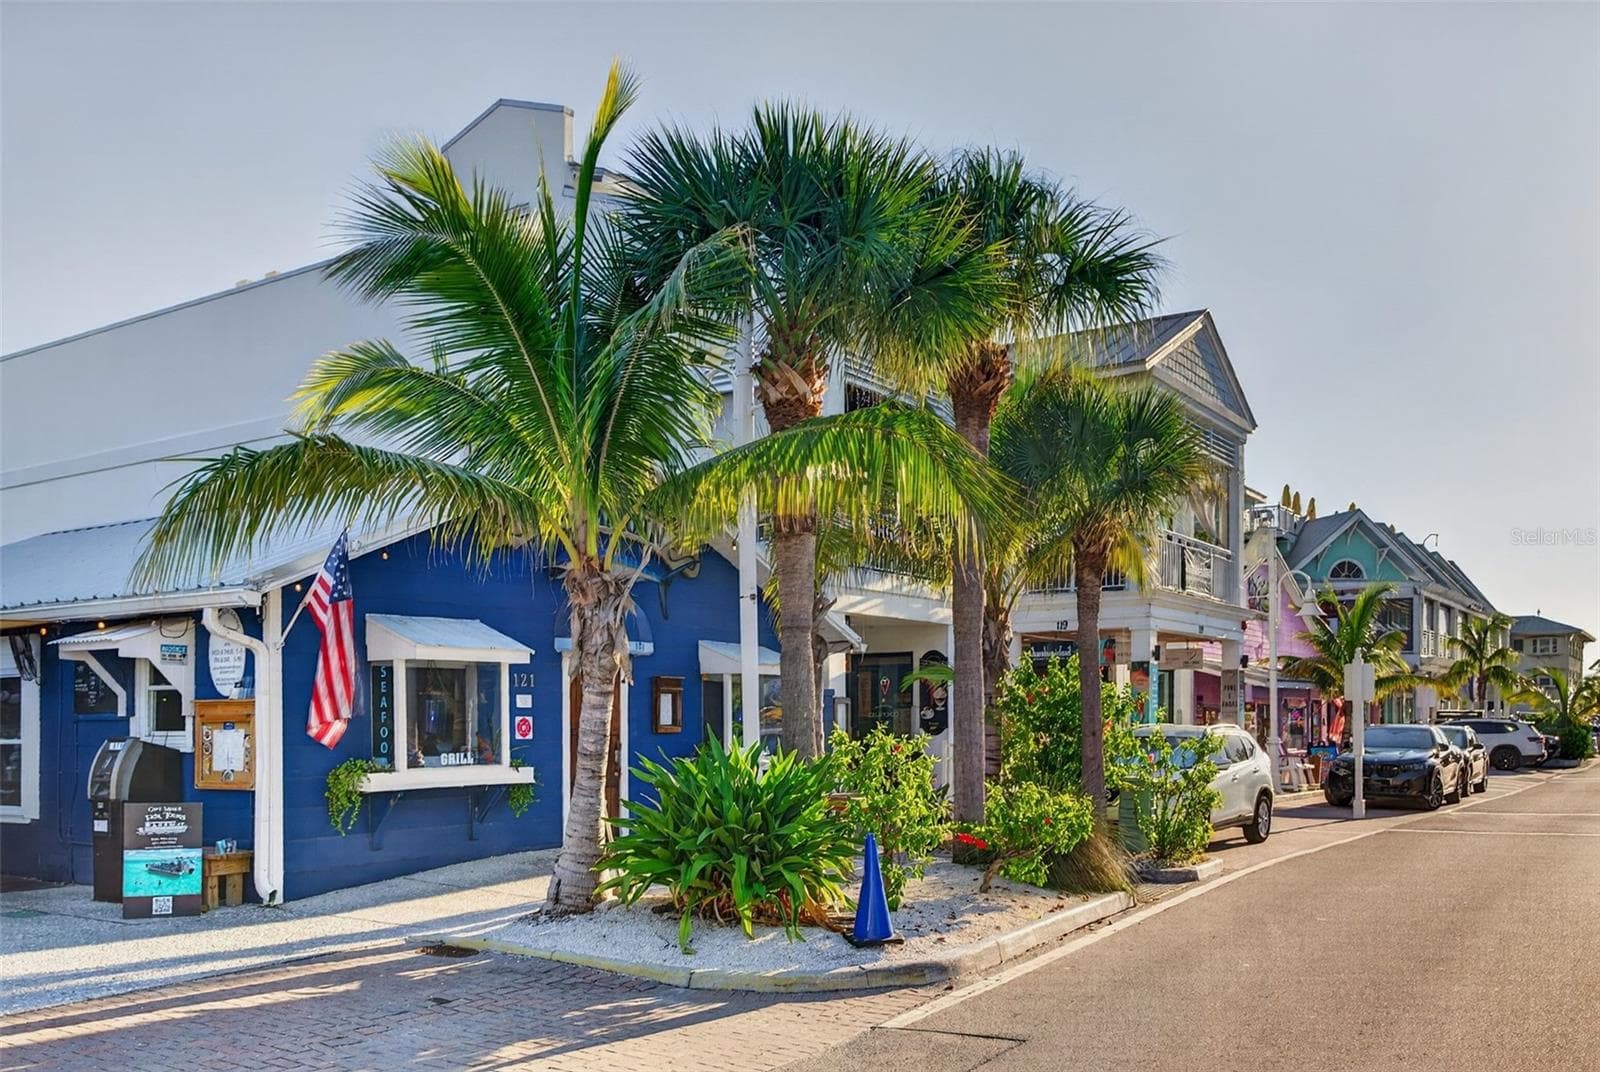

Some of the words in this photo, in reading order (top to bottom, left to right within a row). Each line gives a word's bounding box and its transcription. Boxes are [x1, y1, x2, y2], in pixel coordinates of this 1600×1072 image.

[1056, 620, 1068, 630] 119
[513, 673, 535, 688] 121
[380, 665, 389, 754] SEAFOO
[440, 752, 474, 766] GRILL
